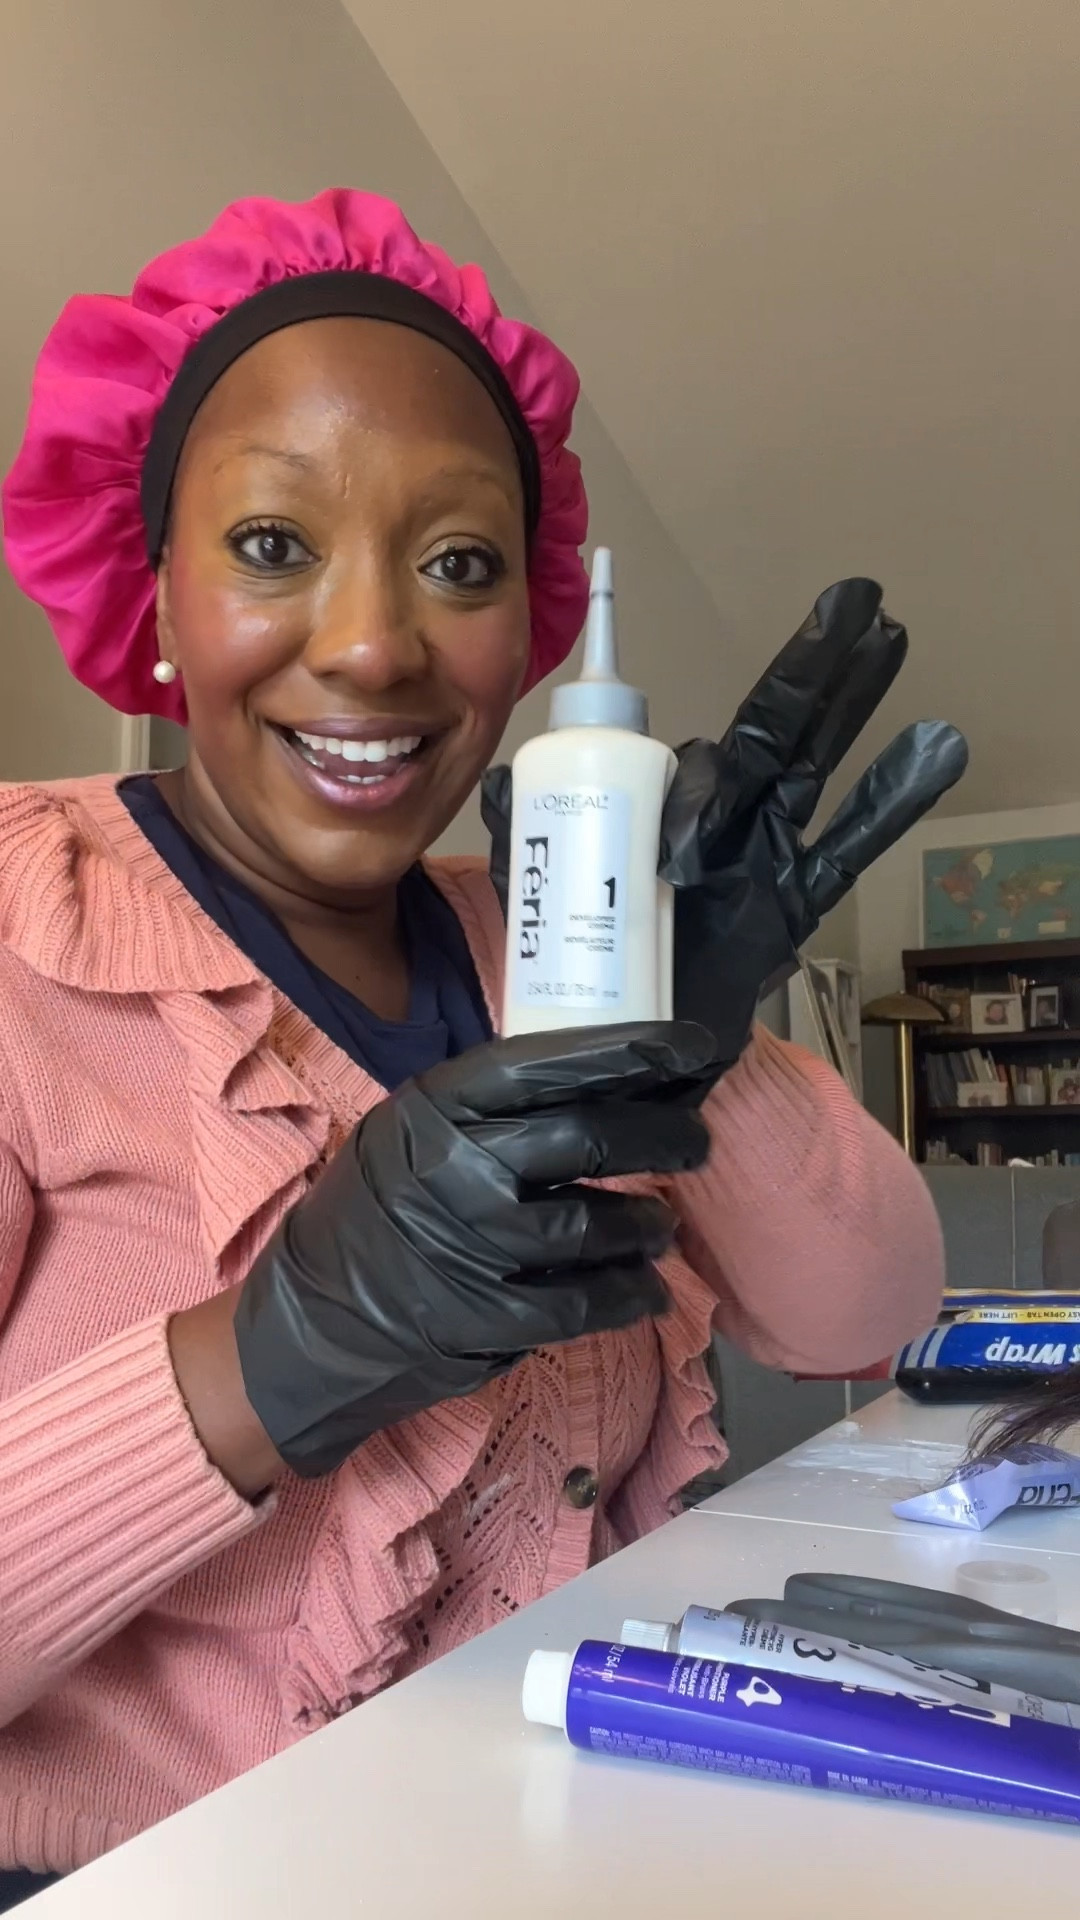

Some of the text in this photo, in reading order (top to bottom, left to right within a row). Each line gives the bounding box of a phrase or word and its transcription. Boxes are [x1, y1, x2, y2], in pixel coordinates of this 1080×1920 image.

[521, 837, 549, 960] Féria
[603, 876, 616, 908] 1
[979, 1311, 1000, 1319] HERE
[1001, 1311, 1018, 1319] LIFT
[1027, 1311, 1043, 1319] TAB
[1043, 1311, 1067, 1319] OPEN
[985, 1336, 1067, 1365] Wrap
[793, 1638, 836, 1662] 3
[678, 1667, 691, 1696] VIOLET
[717, 1672, 730, 1703] PURPLE
[736, 1676, 783, 1707] 4
